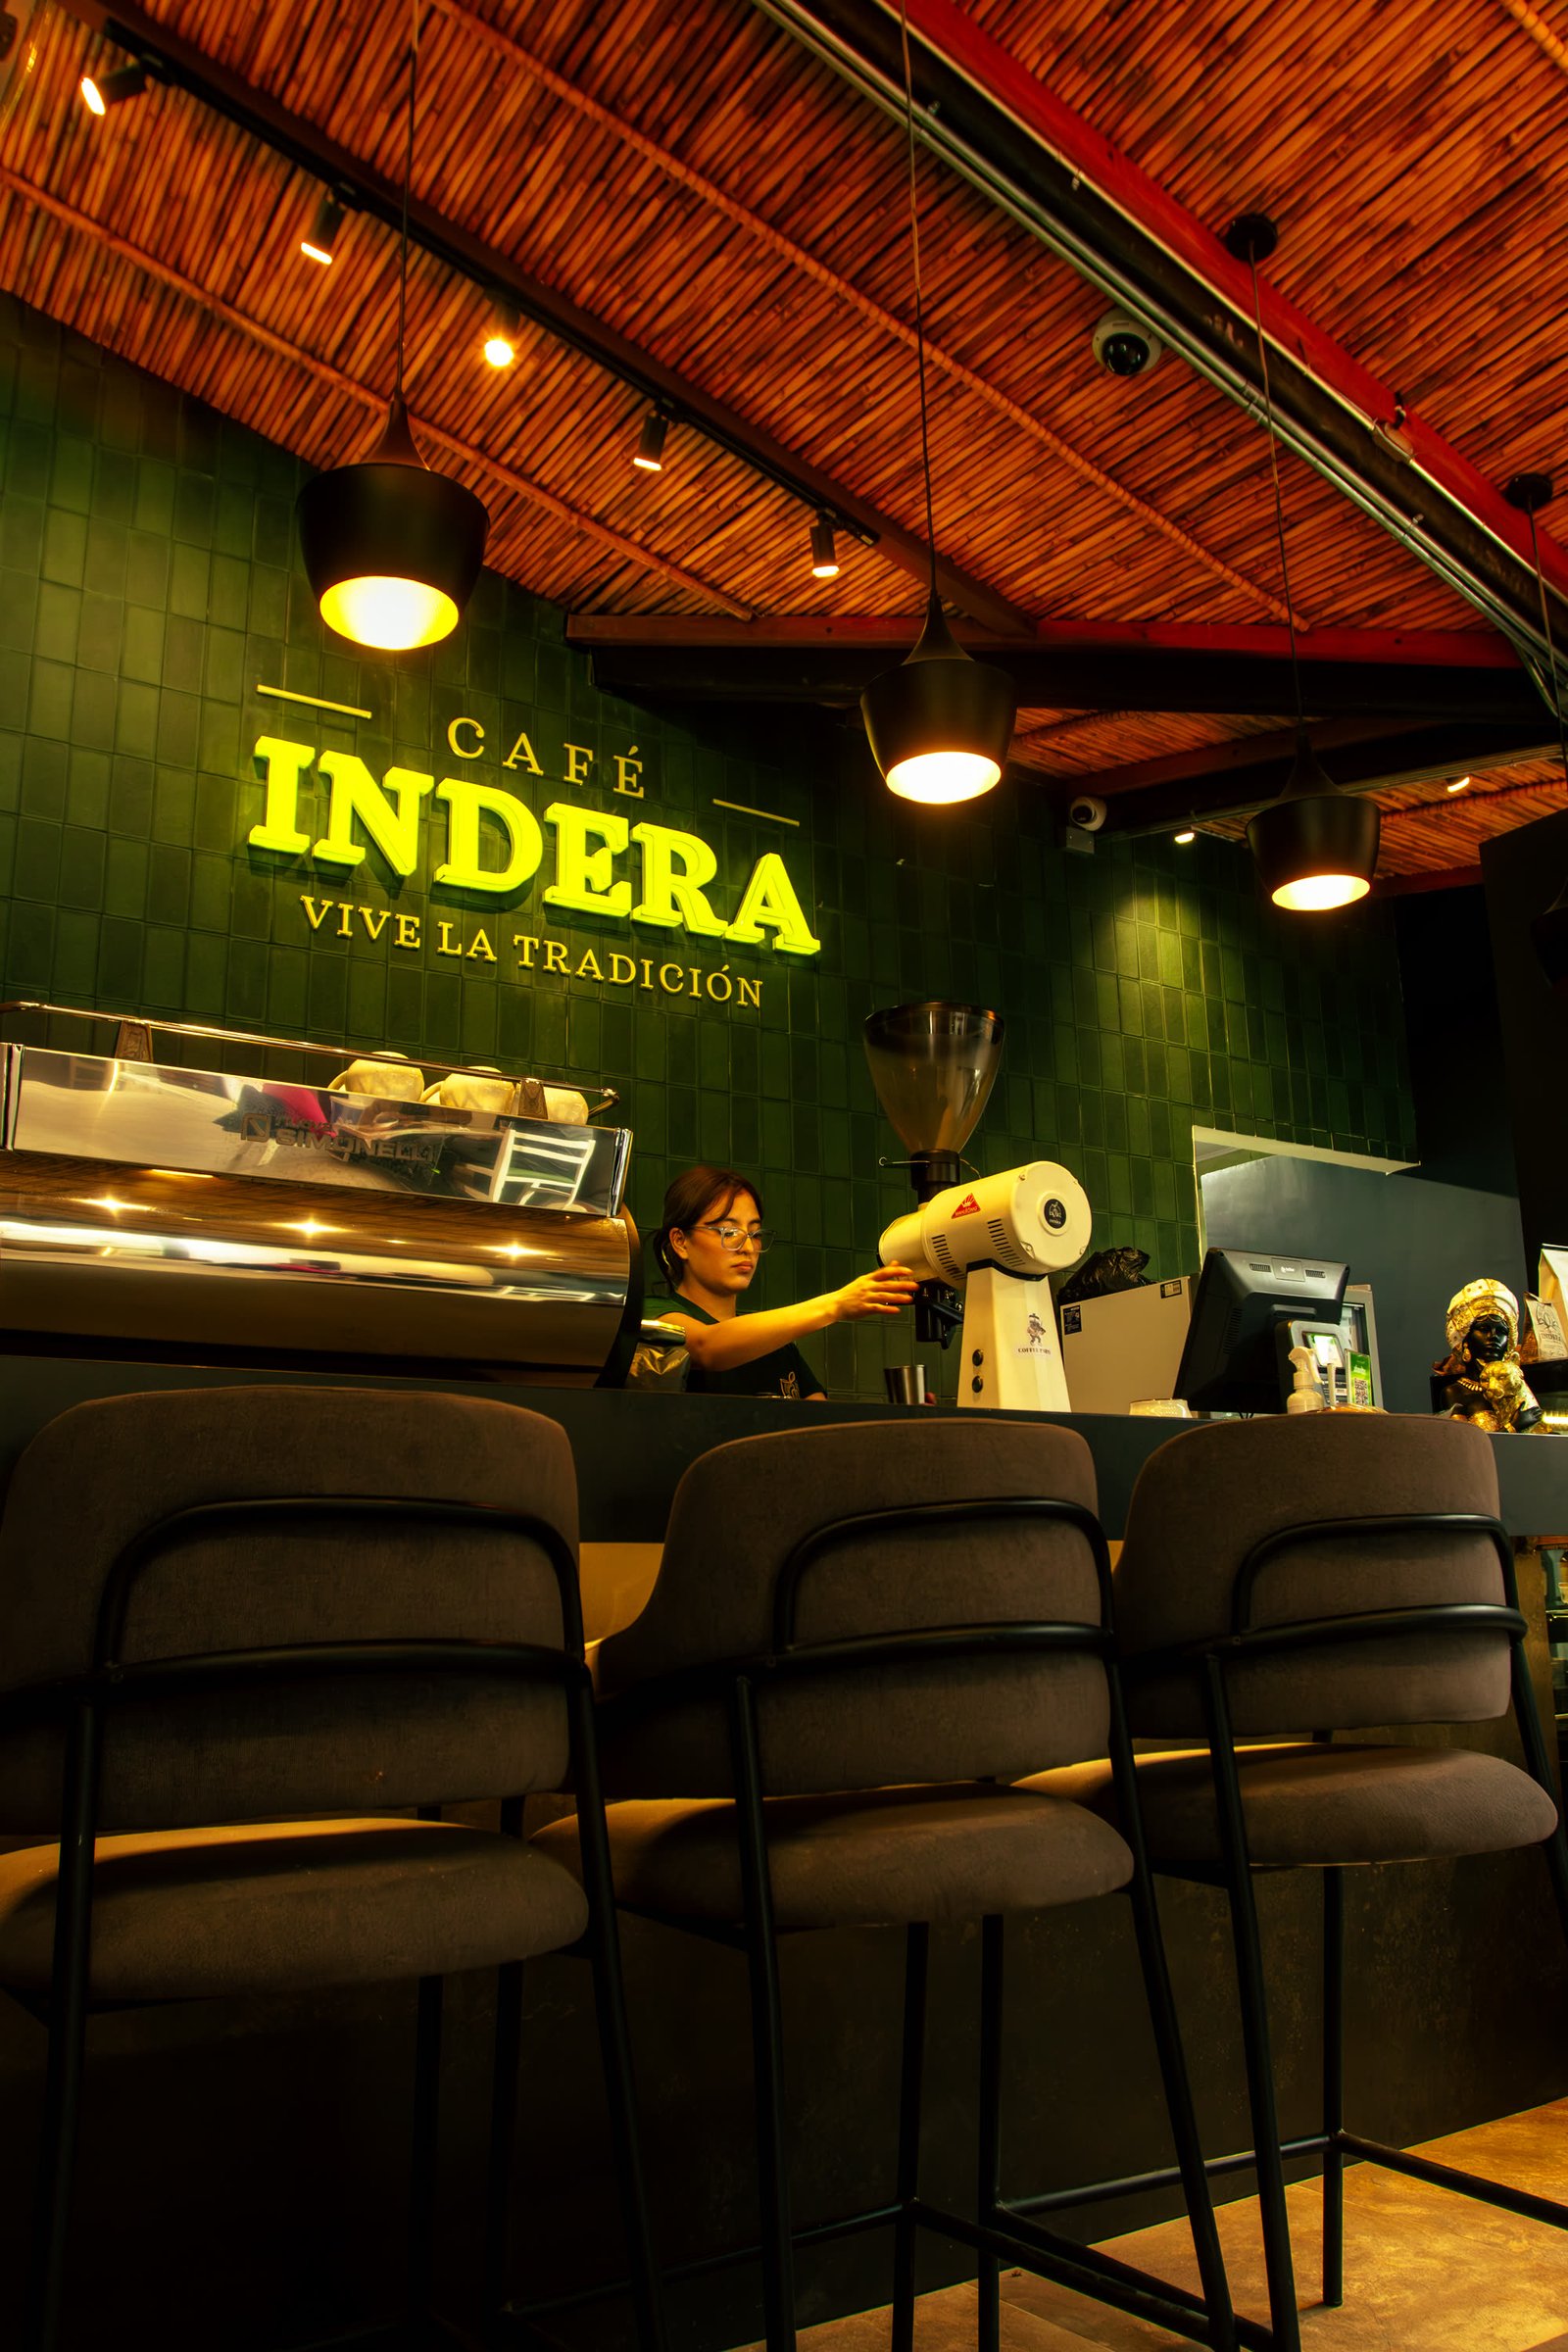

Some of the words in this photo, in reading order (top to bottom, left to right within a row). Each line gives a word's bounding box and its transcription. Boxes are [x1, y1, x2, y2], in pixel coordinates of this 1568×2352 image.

[447, 716, 645, 799] CAFÉ
[247, 735, 821, 956] INDERA
[300, 894, 421, 950] VIVE
[436, 920, 498, 962] LA
[514, 933, 763, 1009] TRADICIÓN
[275, 1129, 435, 1160] SIMONELLI
